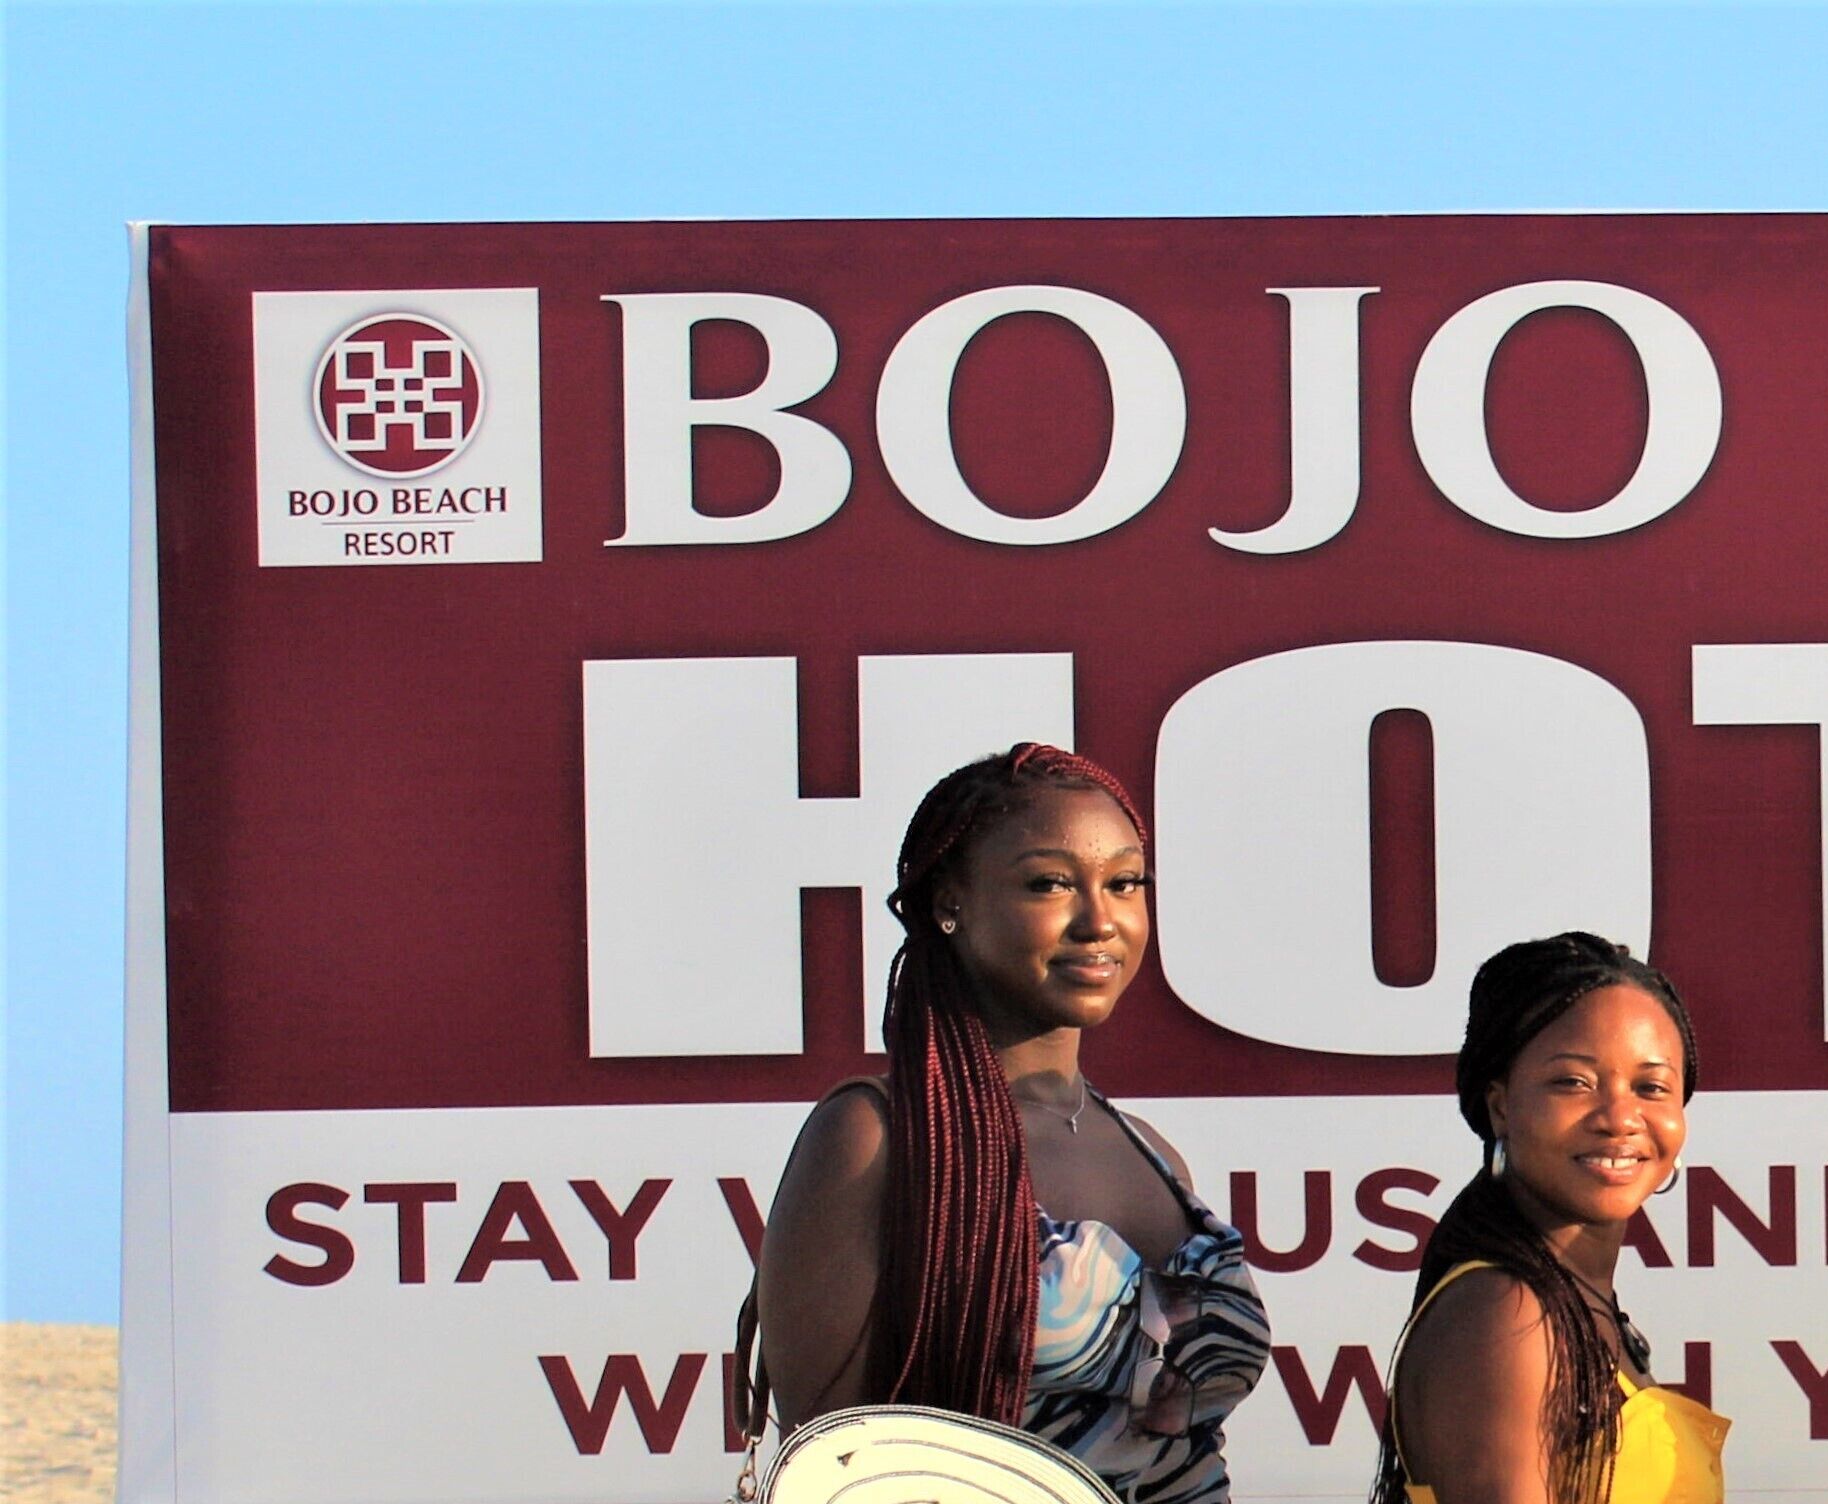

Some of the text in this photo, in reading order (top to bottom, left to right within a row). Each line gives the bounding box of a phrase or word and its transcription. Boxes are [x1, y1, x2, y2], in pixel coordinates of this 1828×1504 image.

[600, 280, 1724, 554] BOJO
[289, 487, 507, 517] BOJO BEACH
[344, 531, 455, 556] RESORT
[263, 1178, 673, 1287] STAY
[1229, 1167, 1441, 1273] US
